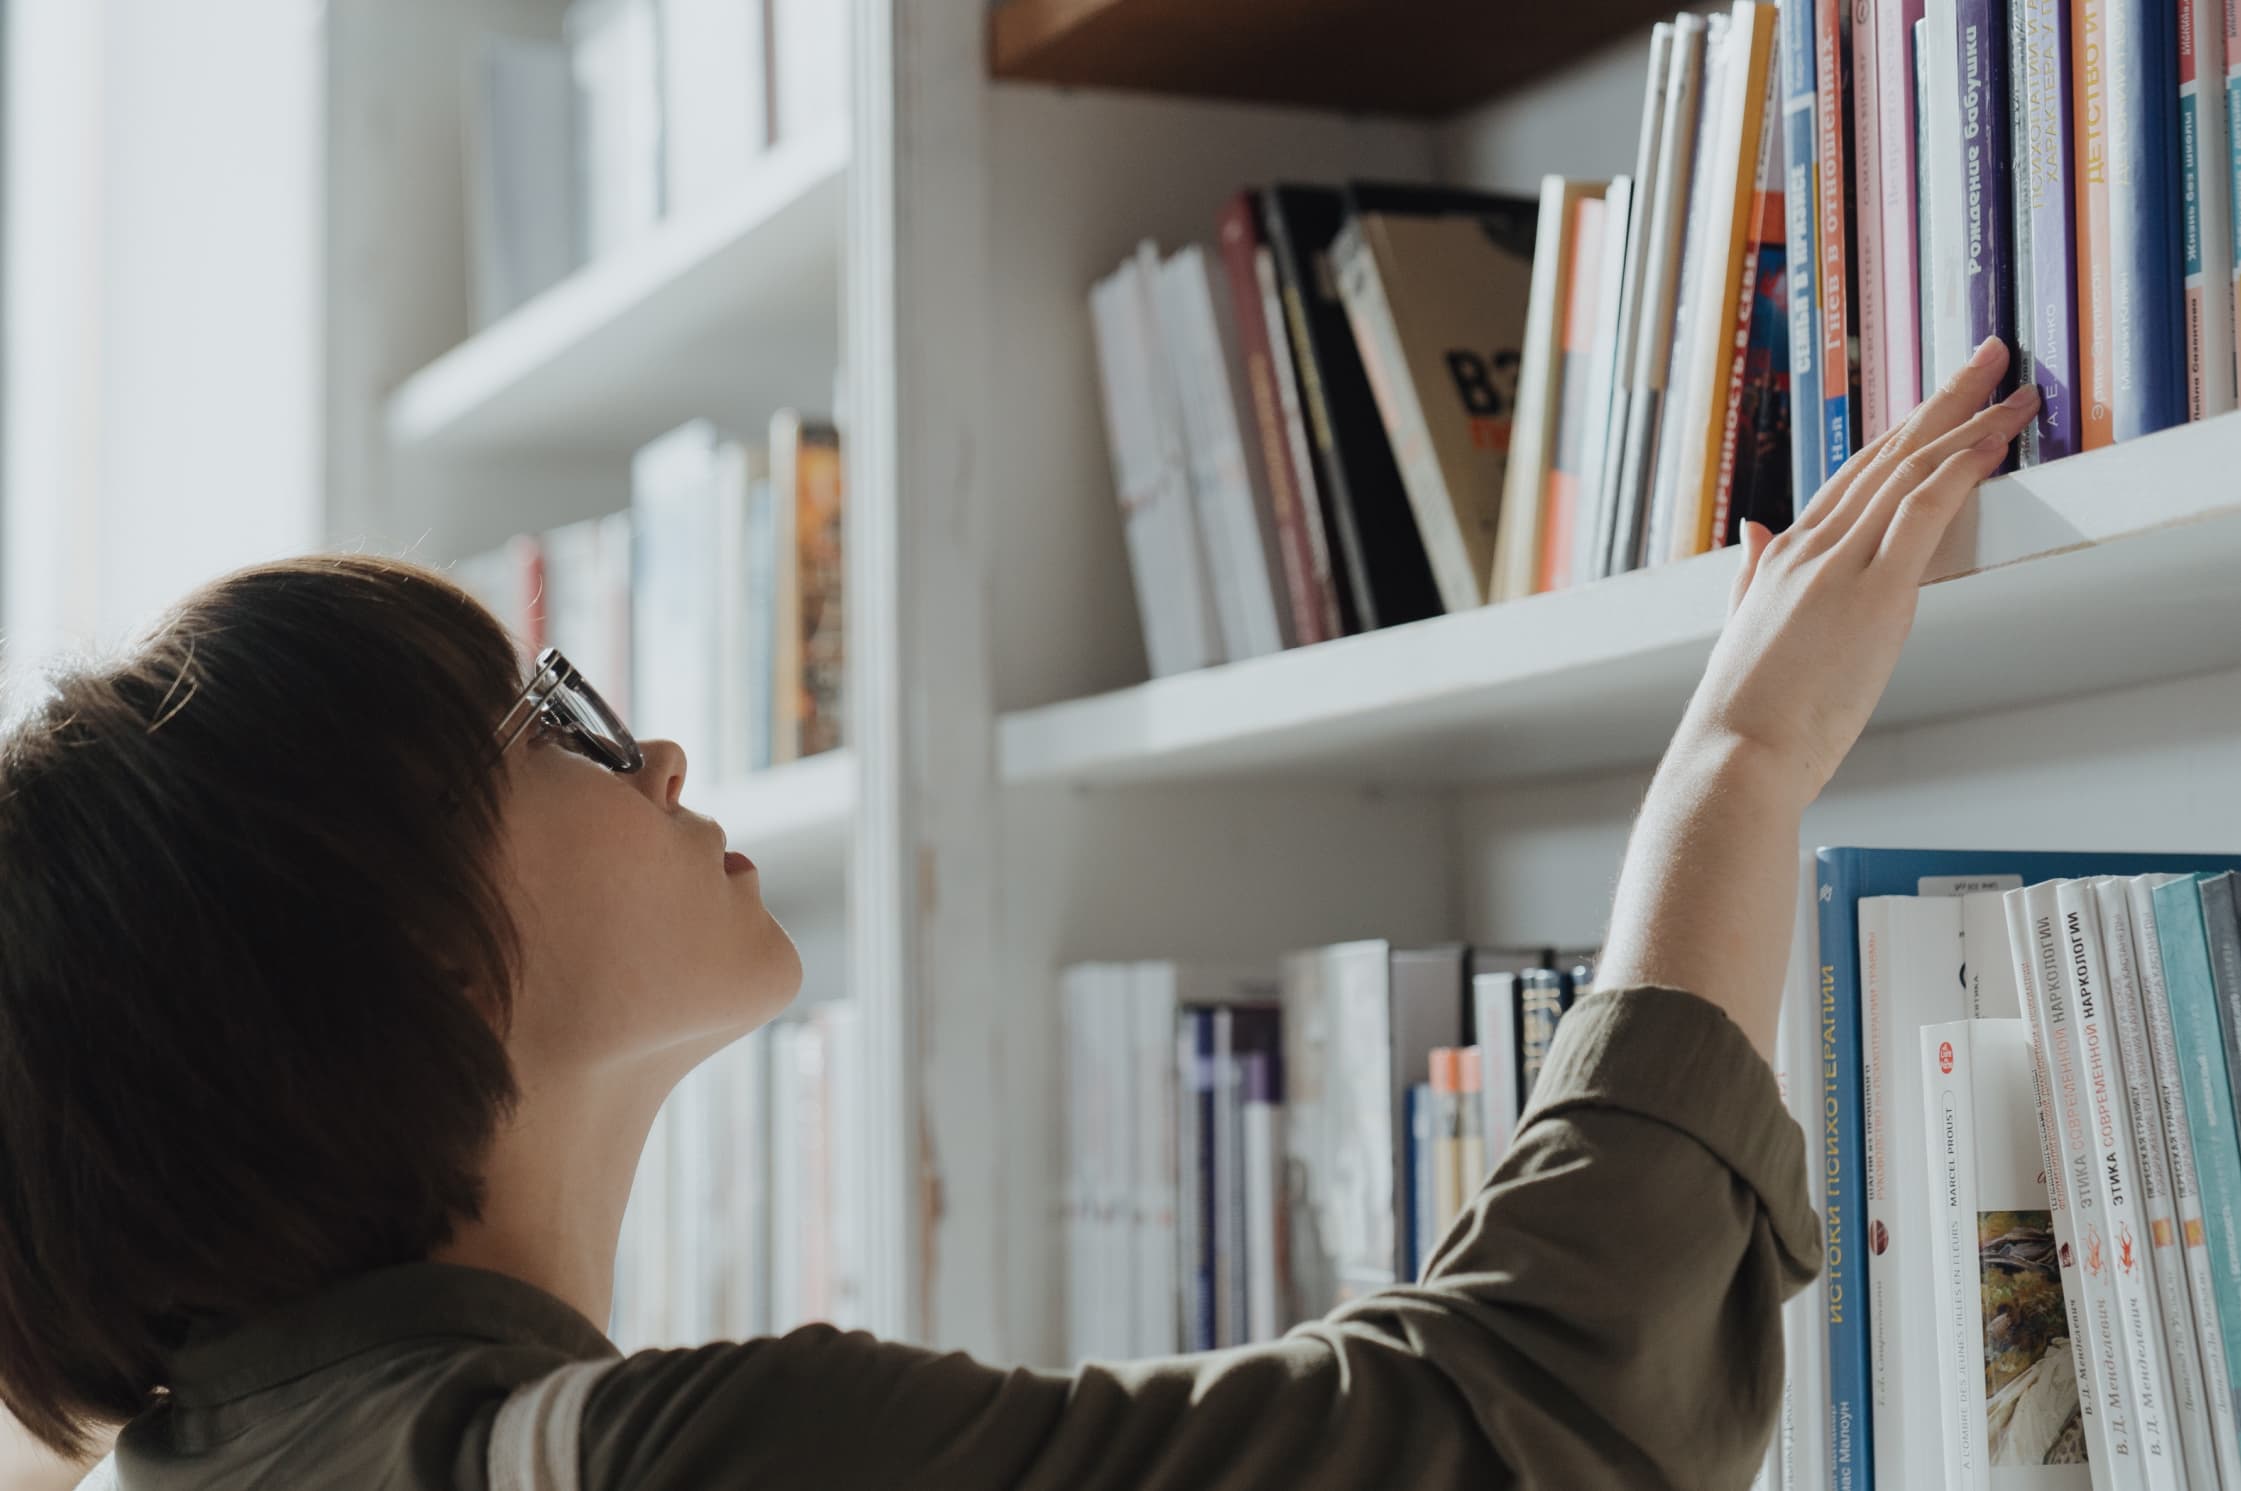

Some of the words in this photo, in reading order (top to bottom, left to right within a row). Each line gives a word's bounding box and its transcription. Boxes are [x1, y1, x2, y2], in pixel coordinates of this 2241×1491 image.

[2026, 17, 2038, 36] И
[2082, 11, 2098, 33] И
[1964, 25, 1982, 138] бабушки
[2027, 41, 2045, 209] ПСИХОПАТИИ
[2042, 46, 2058, 184] ХАРАКТЕРА
[2084, 43, 2105, 185] ДЕТСТВО
[2182, 111, 2194, 168] школы
[1791, 163, 1809, 265] КРИЗИСЕ
[1966, 144, 1983, 276] Рождение
[2184, 172, 2195, 202] без
[2185, 205, 2198, 262] Жизнь
[1739, 252, 1757, 321] СЕБЕ
[1793, 270, 1809, 291] В
[1825, 273, 1841, 349] Гнев
[1794, 295, 1811, 374] СЕМЬЯ
[2044, 304, 2059, 369] Личко
[2036, 916, 2065, 1024] НАРКОЛОГИИ
[2067, 911, 2096, 1019] НАРКОЛОГИИ
[1820, 964, 1841, 1196] ПСИХОТЕРАПИИ
[2054, 1027, 2085, 1151] СОВРЕМЕННОЙ
[2084, 1023, 2115, 1148] СОВРЕМЕННОЙ
[1944, 1107, 1956, 1155] PROUST
[1947, 1158, 1959, 1207] MARCEL
[2074, 1154, 2093, 1209] ЭТИКА
[2105, 1152, 2124, 1207] ЭТИКА
[1826, 1206, 1844, 1324] ИСТОКИ
[1950, 1219, 1962, 1265] FLEURS
[1953, 1288, 1965, 1328] FILLES
[2068, 1298, 2087, 1381] Менделевич
[1955, 1332, 1967, 1376] JEUNES
[2096, 1296, 2122, 1409] Менделевич
[2128, 1296, 2155, 1409] Менделевич
[1957, 1376, 1968, 1403] DES
[1838, 1401, 1854, 1463] Малоун
[2111, 1414, 2127, 1435] Д.
[2115, 1439, 2129, 1456] В.
[2145, 1414, 2160, 1435] Д.
[2149, 1439, 2162, 1457] В.
